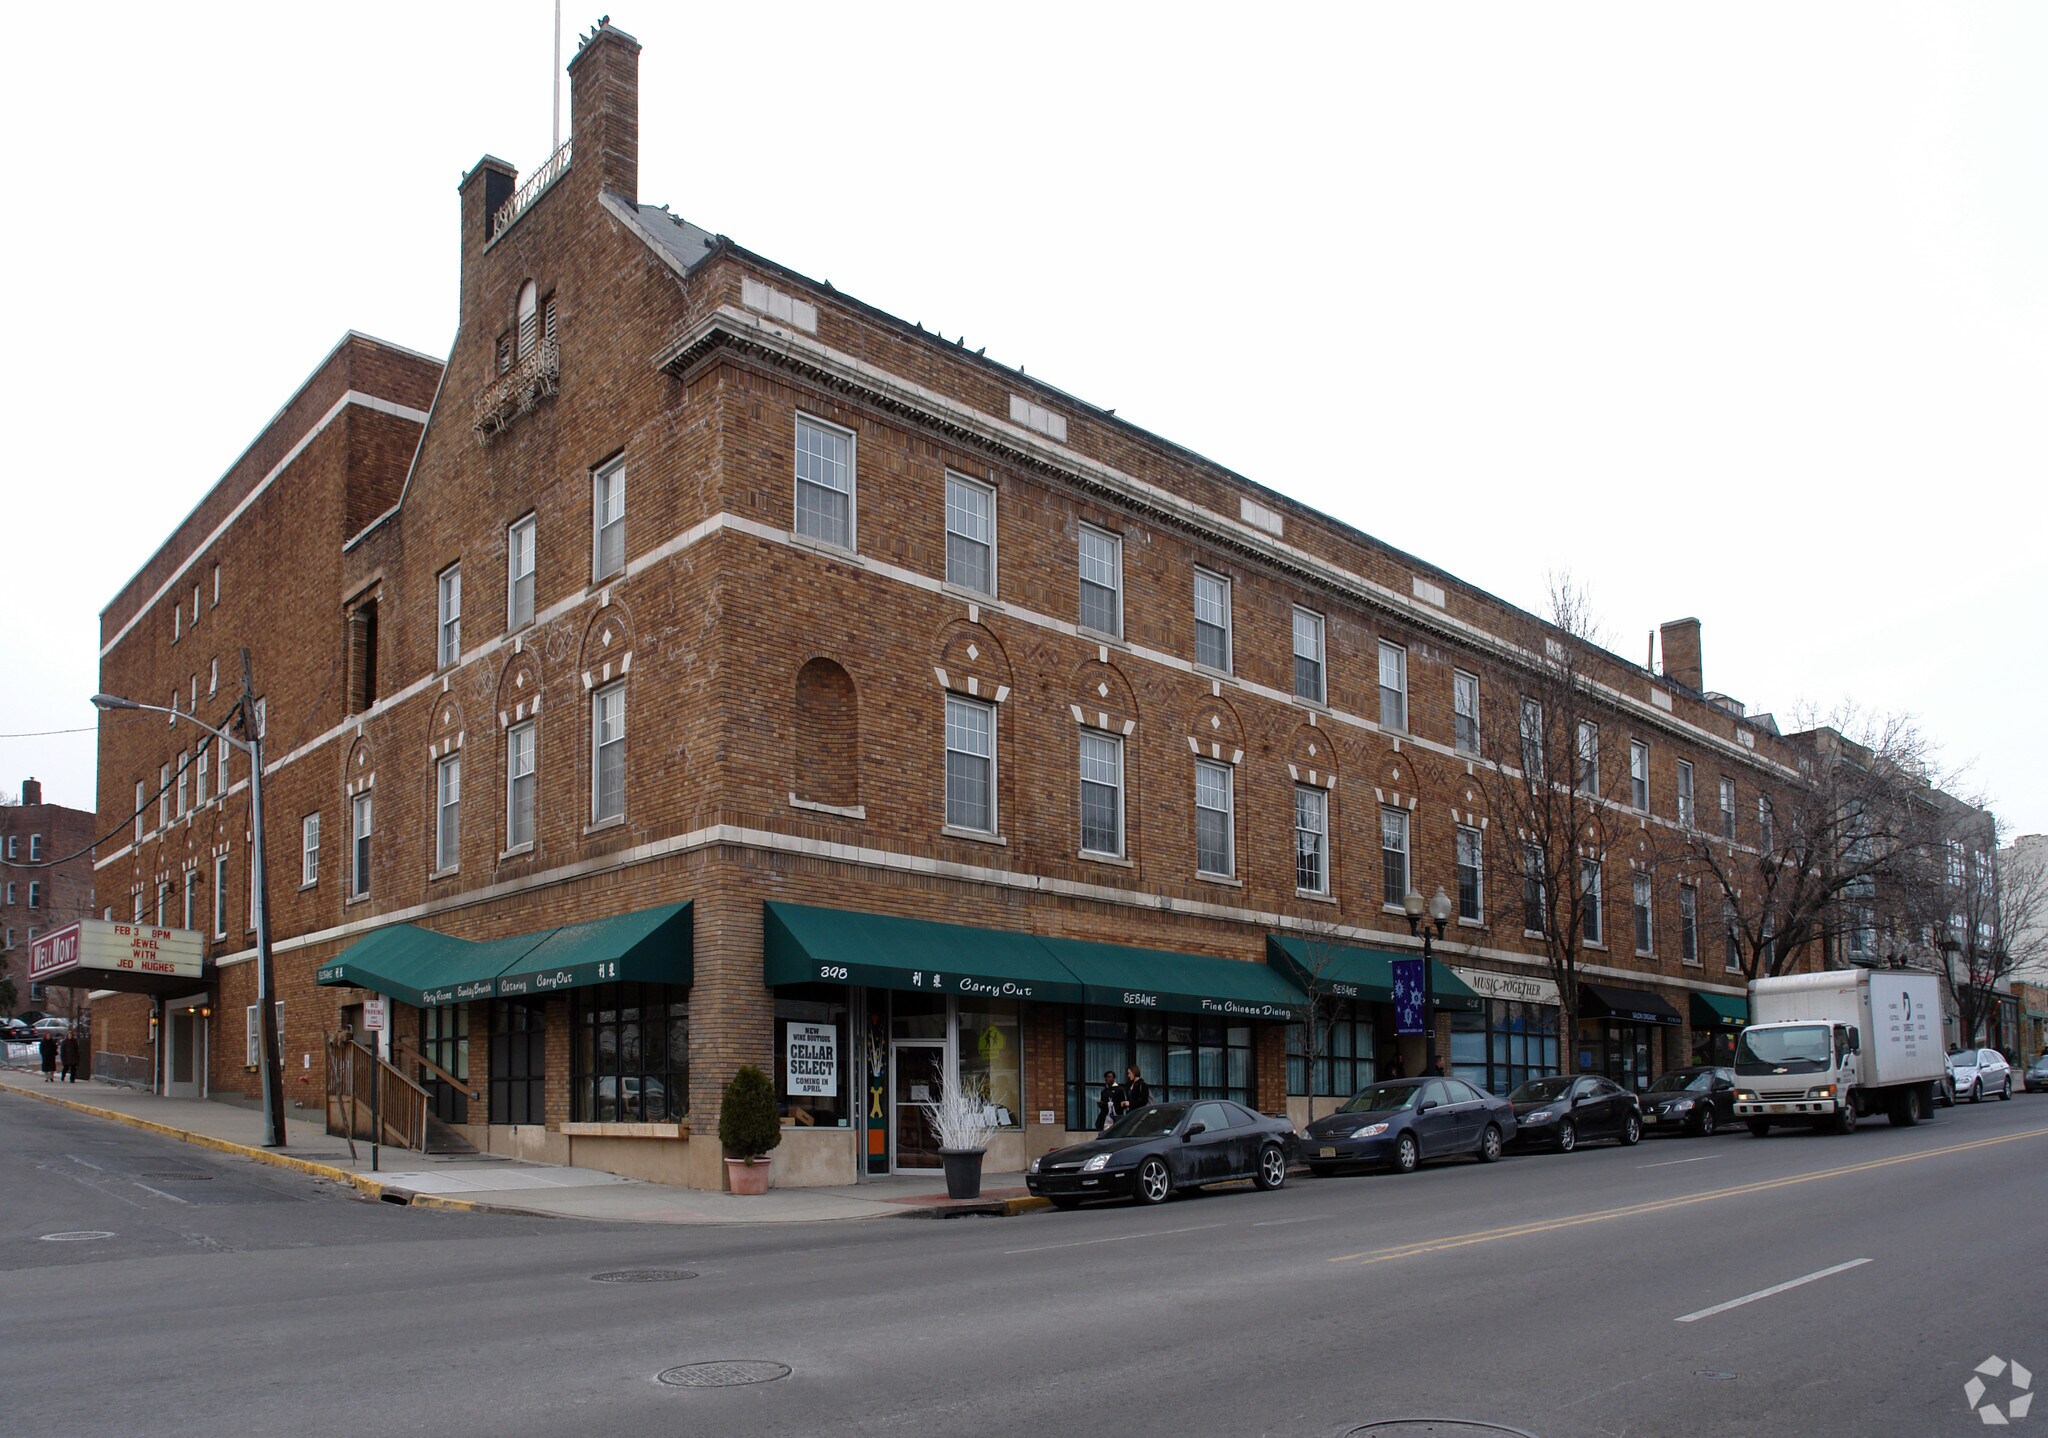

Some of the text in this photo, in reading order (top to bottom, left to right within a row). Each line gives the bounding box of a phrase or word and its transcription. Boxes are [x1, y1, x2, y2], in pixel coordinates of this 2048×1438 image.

[114, 925, 171, 940] FEB 3 8PM
[130, 938, 160, 950] JEWEL
[132, 949, 157, 961] WITH
[116, 959, 175, 973] JED HUGHES
[820, 965, 848, 980] 398
[501, 979, 527, 993] Catering
[536, 973, 557, 988] Carry
[556, 971, 573, 984] Out
[959, 977, 1033, 997] Carry Out
[1472, 976, 1541, 996] MUSIC TOGETHER
[1123, 992, 1157, 1006] SESAME
[1201, 999, 1291, 1019] Fine Chinese Dining
[793, 1033, 831, 1043] WINE BOUTIQUE
[804, 1027, 820, 1035] NEW
[790, 1043, 834, 1060] CELLAR
[790, 1059, 834, 1076] SELECT
[795, 1077, 829, 1086] COMING IN
[802, 1085, 822, 1093] APRIL
